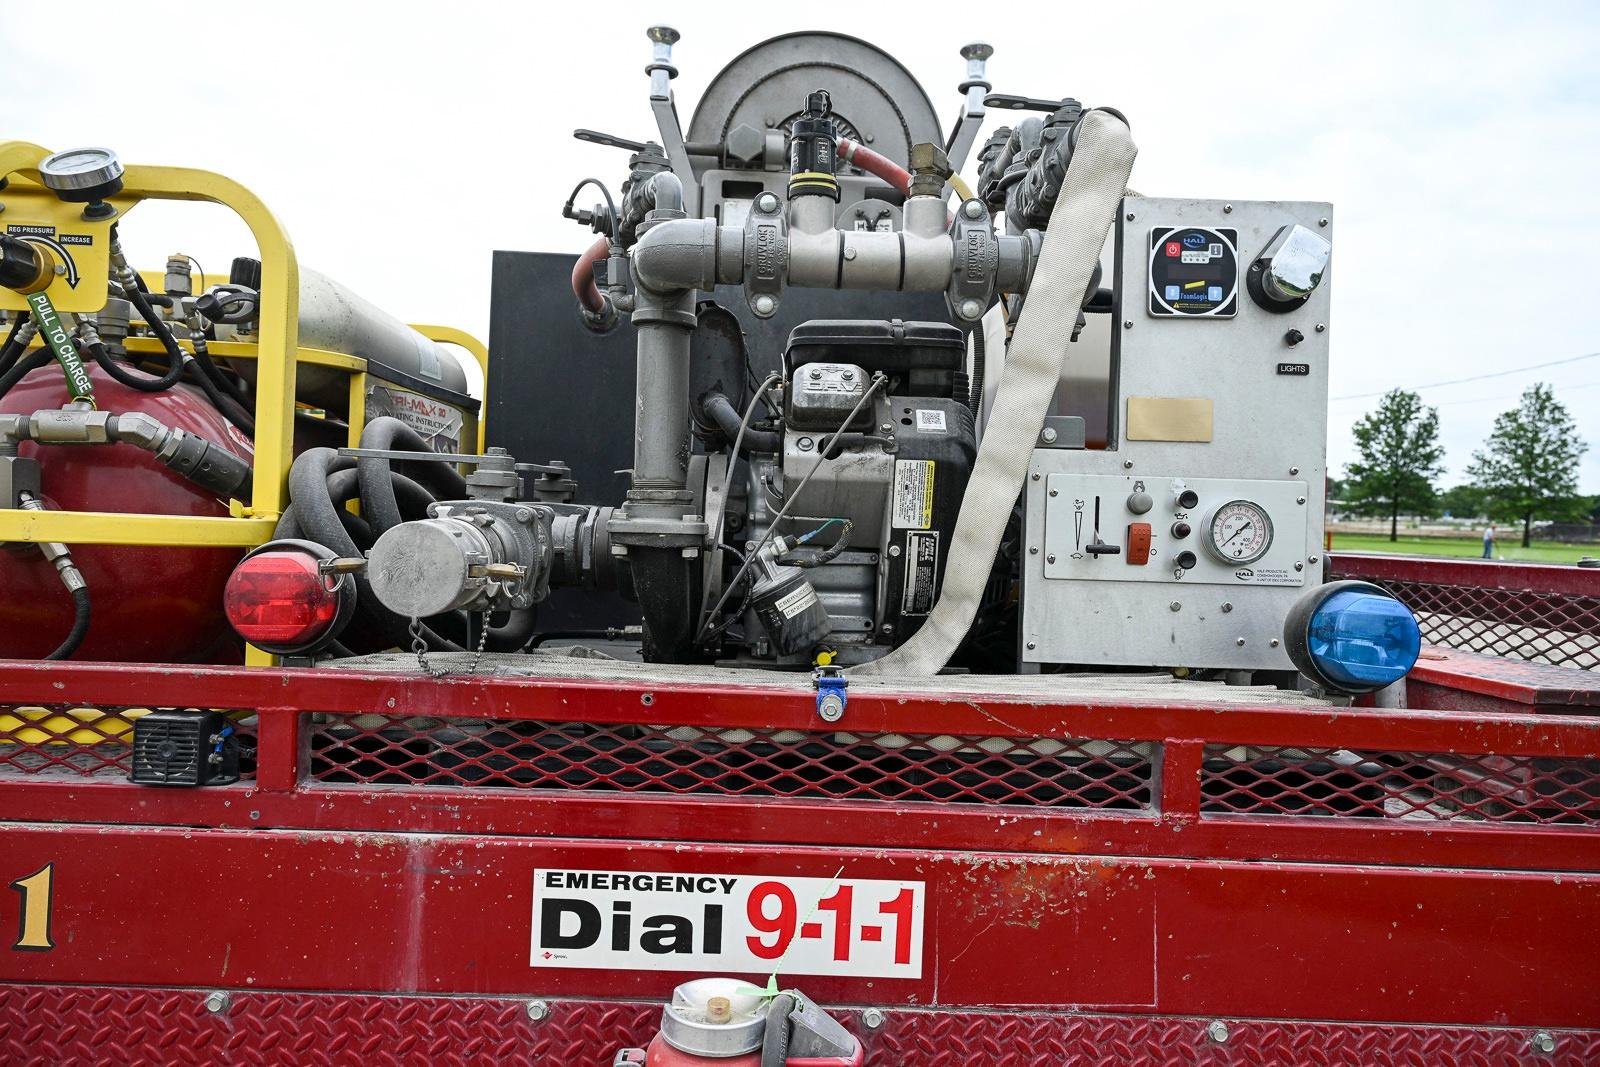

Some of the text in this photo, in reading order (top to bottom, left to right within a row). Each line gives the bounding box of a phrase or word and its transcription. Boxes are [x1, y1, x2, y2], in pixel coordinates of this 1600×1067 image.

[758, 229, 768, 274] GRUVLOK
[968, 233, 978, 278] GRUVLOK
[32, 295, 92, 394] PULL TO CHARGE
[1280, 365, 1306, 373] LIGHTS
[545, 872, 738, 895] EMERGENCY
[8, 861, 57, 952] 1
[540, 881, 914, 965] Dial 9-1-1
